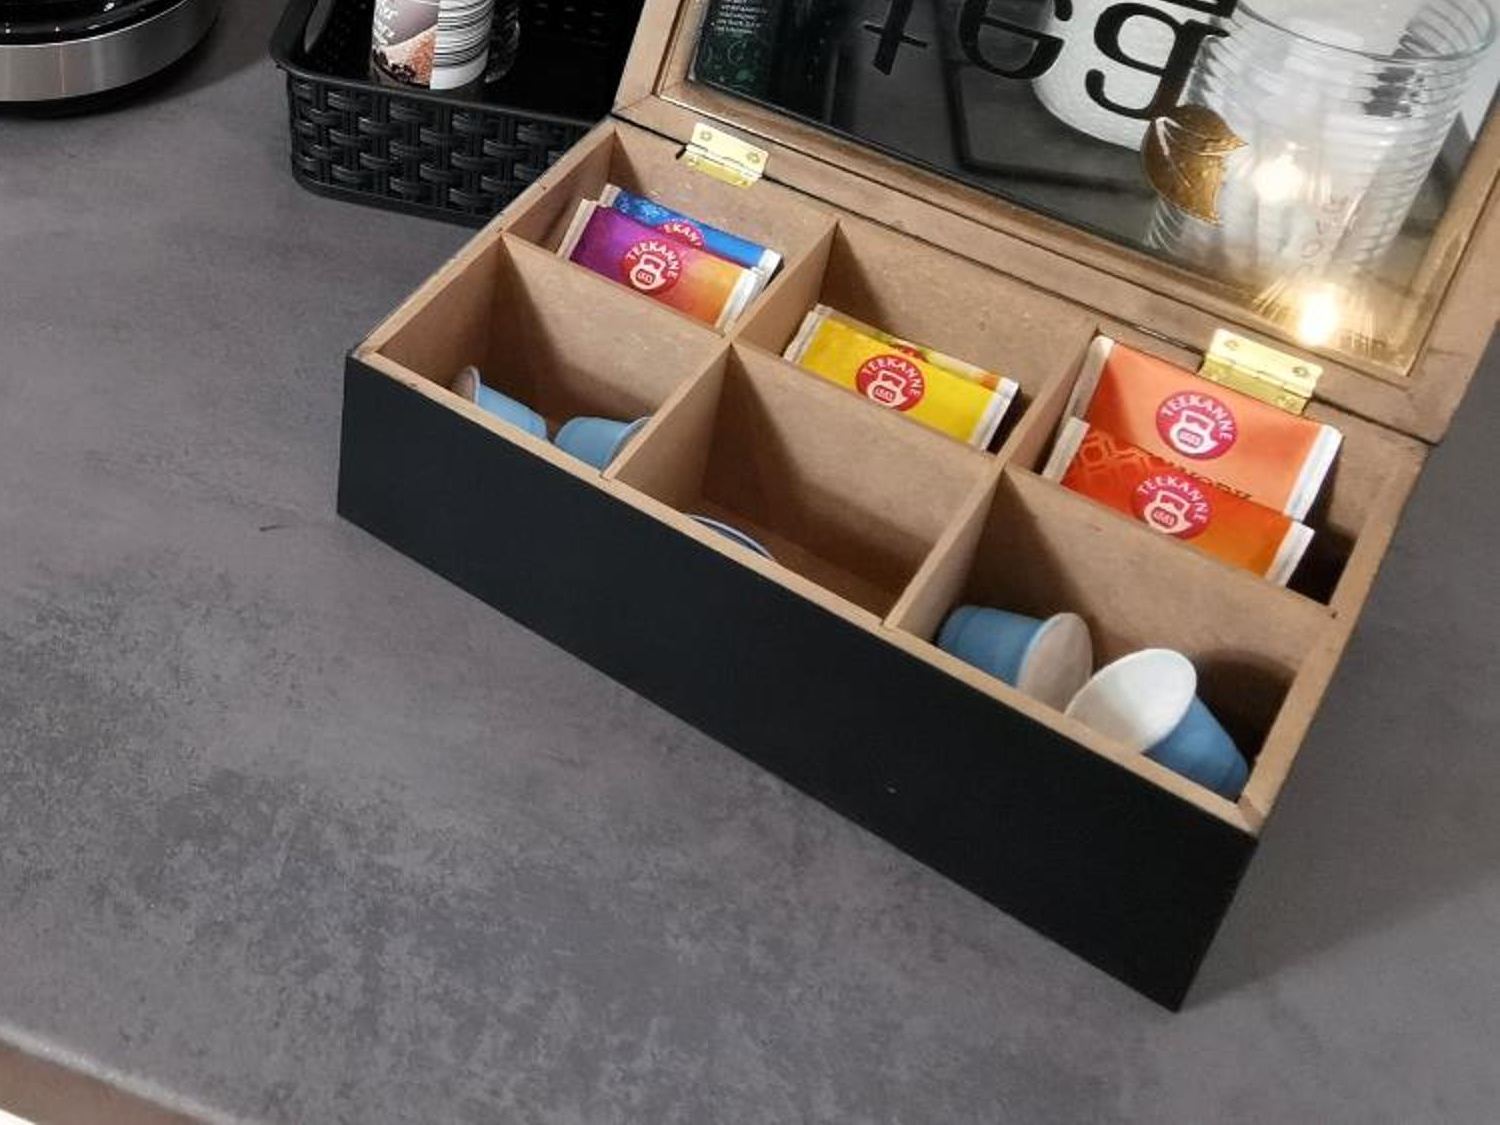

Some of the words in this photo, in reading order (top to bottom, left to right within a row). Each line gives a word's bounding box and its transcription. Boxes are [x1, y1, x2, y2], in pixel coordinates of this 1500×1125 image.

[625, 241, 679, 279] TEEKANNE
[861, 357, 922, 396] TEEKANNE
[1160, 394, 1234, 442] TEEKANNE
[1136, 475, 1209, 524] TEEKANNE
